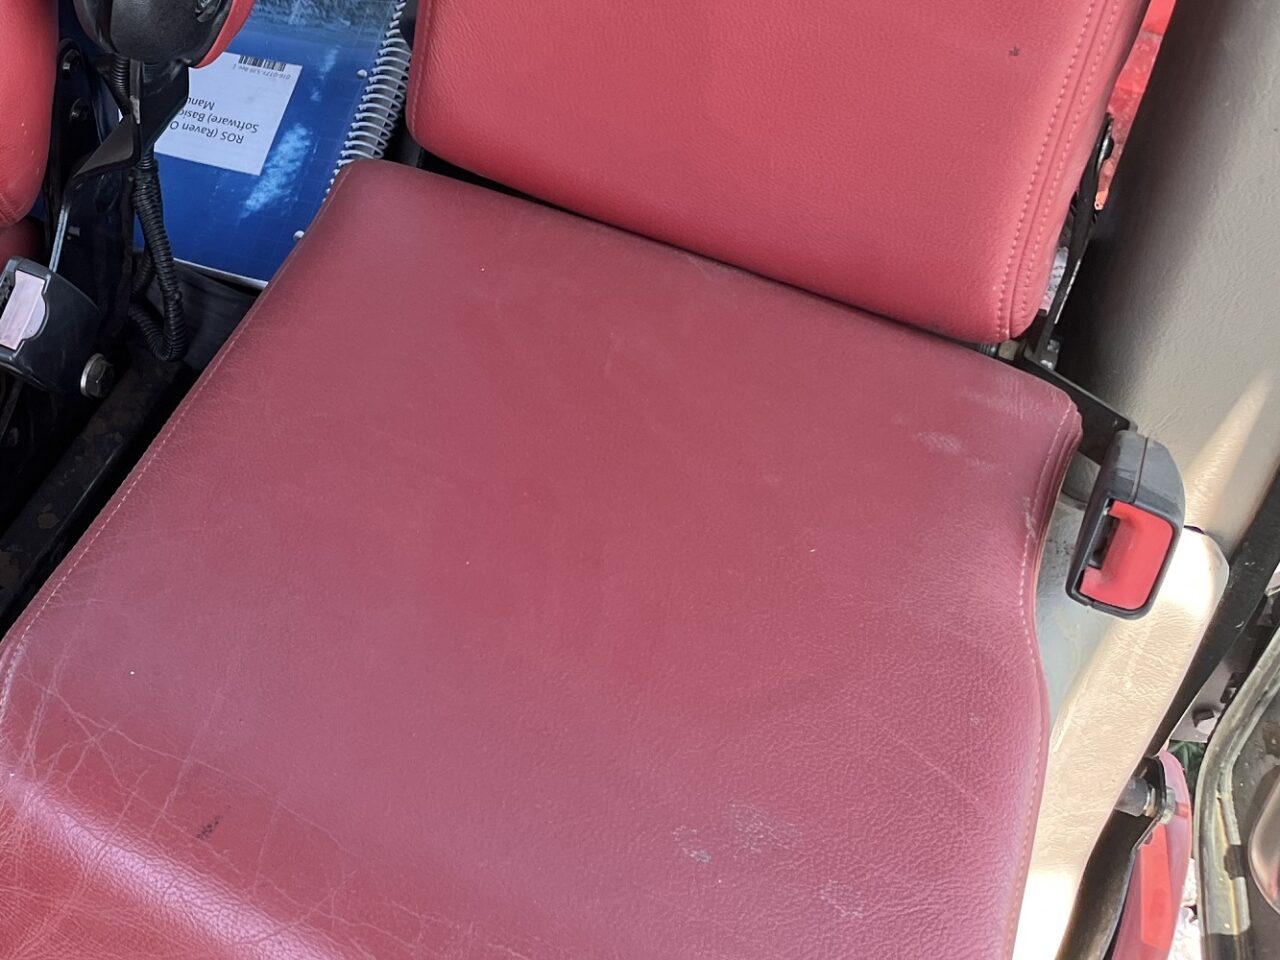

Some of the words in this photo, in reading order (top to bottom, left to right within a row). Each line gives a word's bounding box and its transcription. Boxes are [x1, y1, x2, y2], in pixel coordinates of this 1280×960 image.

[187, 97, 216, 111] Manu
[181, 121, 219, 139] (Raven
[207, 113, 260, 134] Software)
[220, 131, 245, 145] ROS
